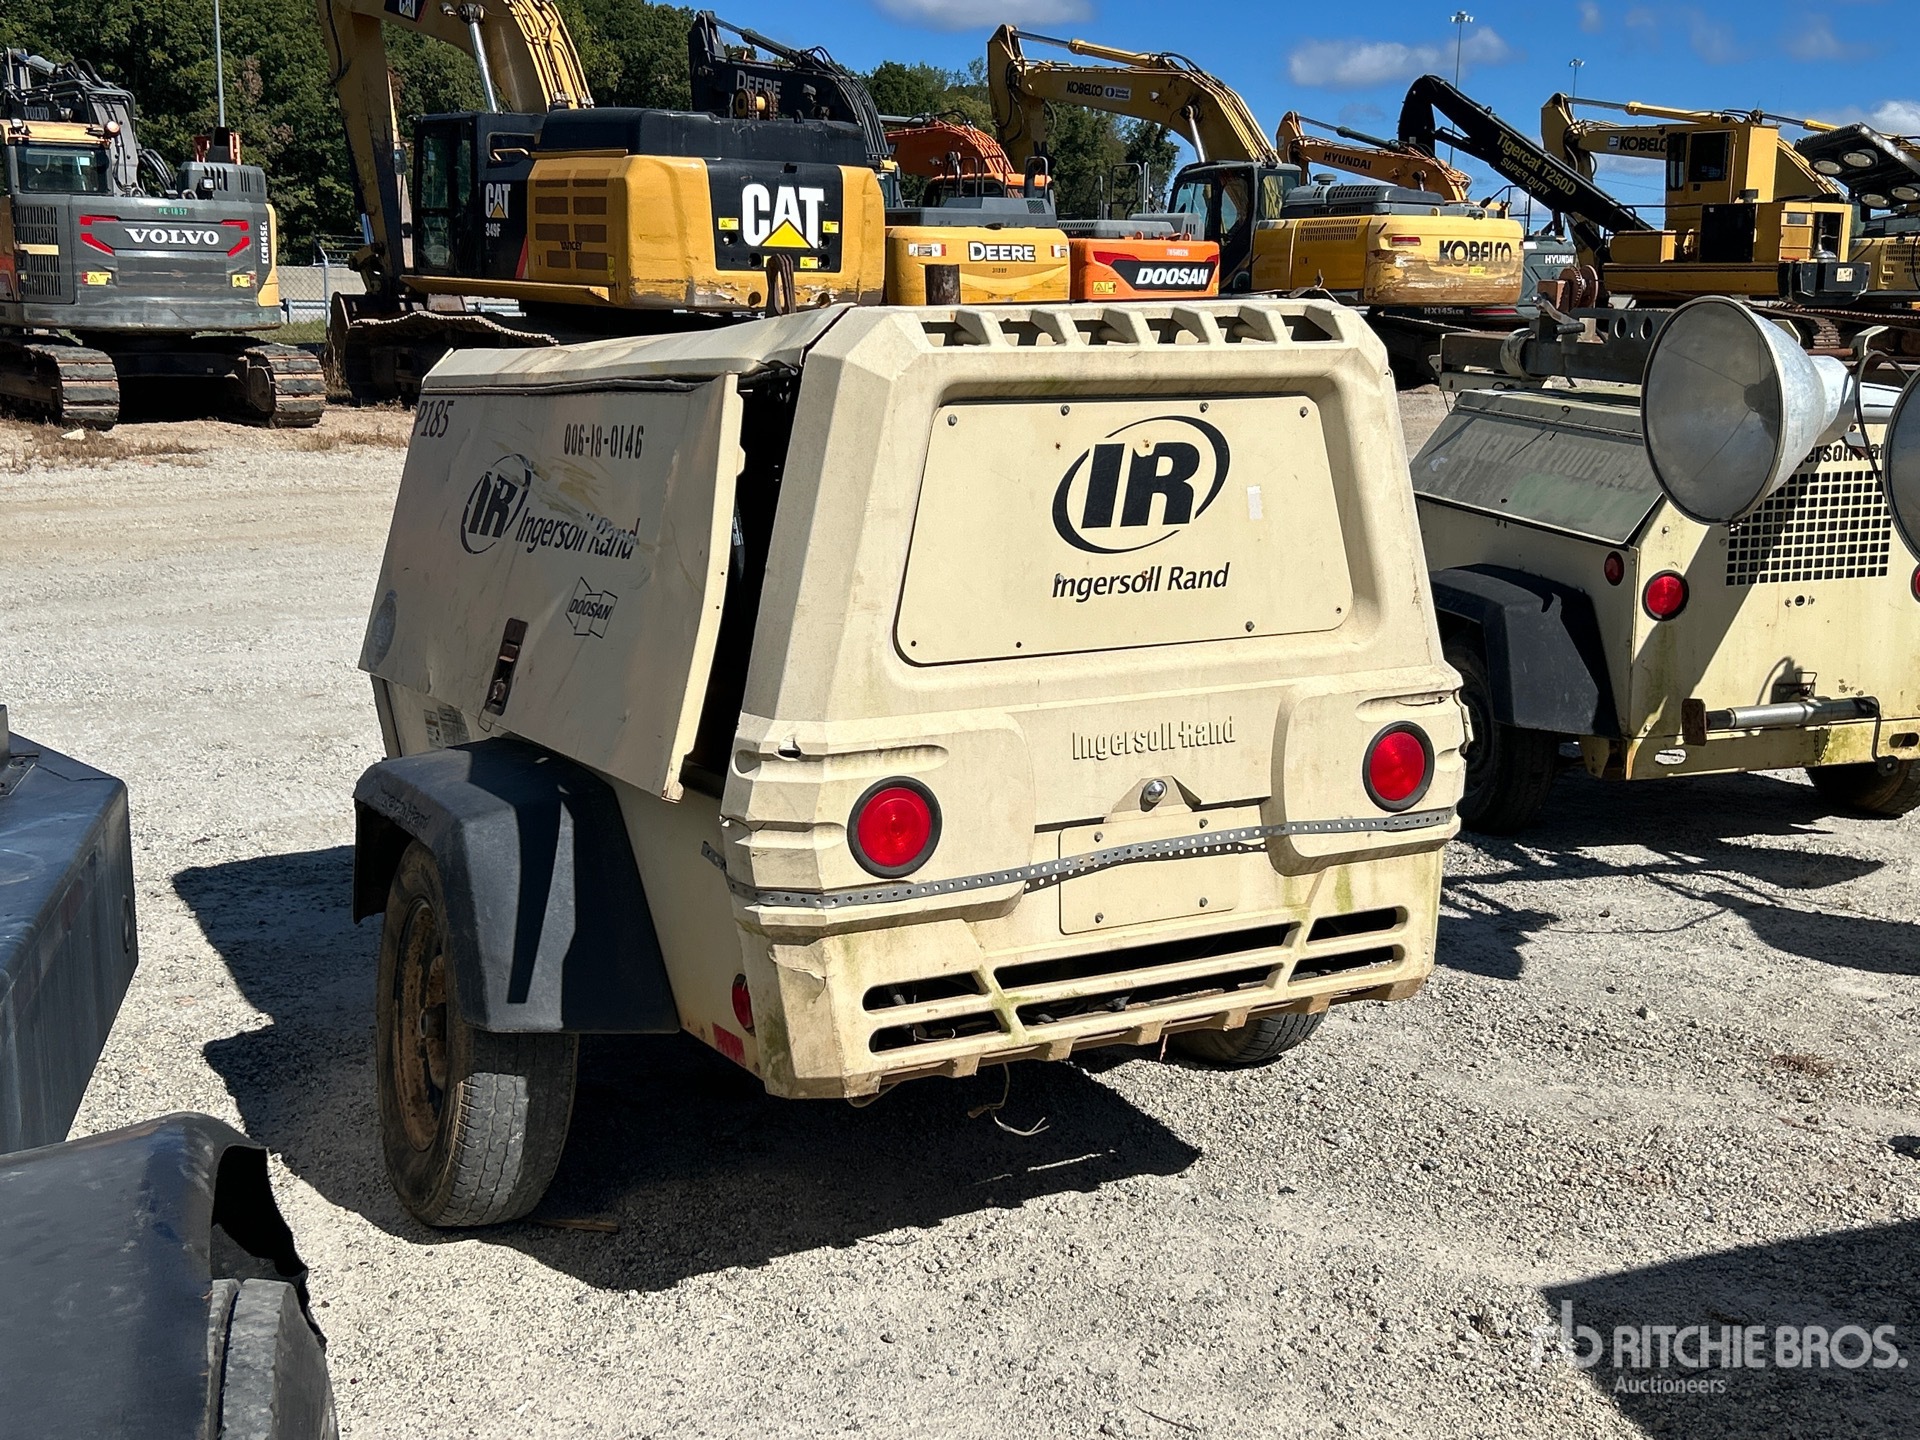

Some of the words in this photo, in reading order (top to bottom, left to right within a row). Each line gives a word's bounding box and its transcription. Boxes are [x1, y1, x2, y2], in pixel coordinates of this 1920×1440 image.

[736, 69, 782, 99] DEERE
[1066, 80, 1104, 97] KOBELCO
[23, 106, 50, 120] VOLVO
[1620, 136, 1667, 152] KOBELC
[1323, 151, 1372, 170] HYUNDAI
[1496, 131, 1543, 172] Tigercat
[1539, 163, 1577, 196] T250D
[1500, 157, 1528, 180] SUPER
[1526, 176, 1551, 196] DUTY
[485, 182, 511, 218] CAT
[742, 183, 824, 249] CAT
[125, 228, 220, 245] VOLVO
[968, 241, 1036, 262] DEERE
[1439, 240, 1512, 266] KOBELCO
[1545, 255, 1575, 265] HYUNDAI
[1135, 268, 1209, 285] DOOSAN
[414, 400, 455, 438] P185
[1081, 442, 1201, 529] IR
[468, 471, 519, 538] IR
[515, 507, 596, 553] Ingersoll
[586, 516, 641, 560] Rand
[1052, 566, 1163, 602] Ingersoll
[1168, 563, 1231, 591] Rand
[569, 598, 614, 621] DOOSAN
